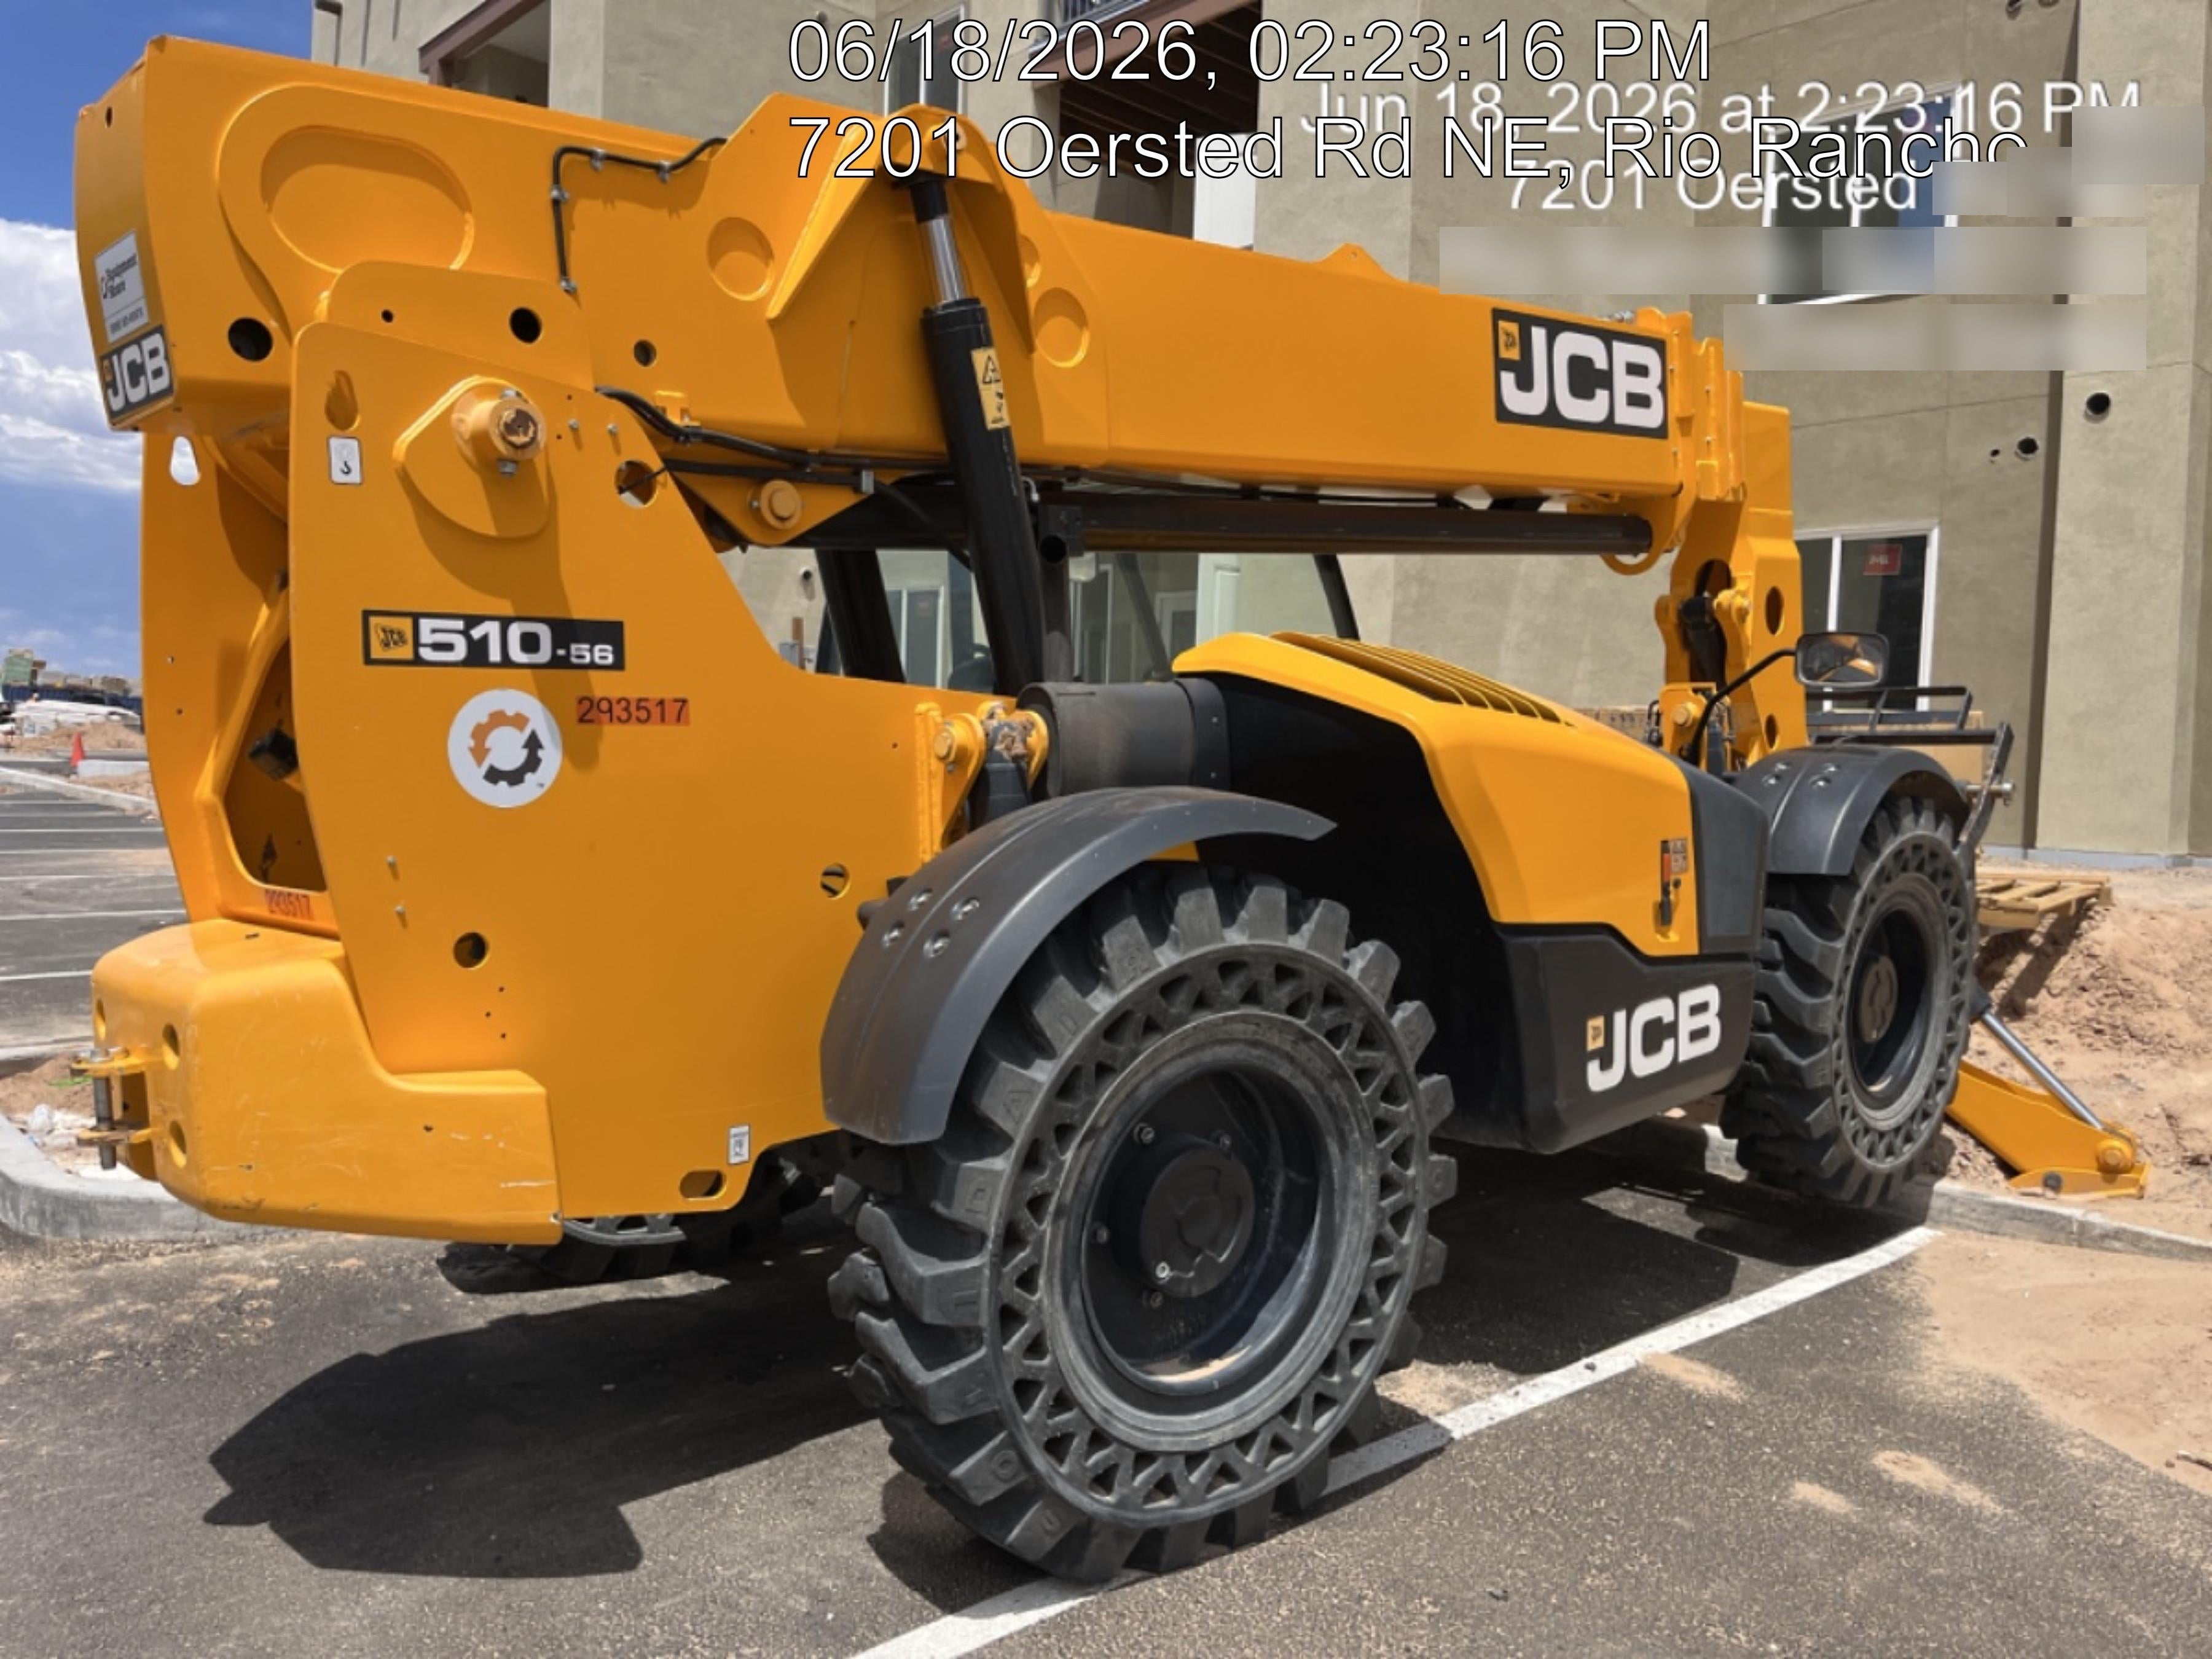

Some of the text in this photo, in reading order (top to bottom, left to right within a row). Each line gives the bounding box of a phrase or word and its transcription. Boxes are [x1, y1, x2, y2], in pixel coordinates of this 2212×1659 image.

[106, 332, 170, 412] JCB
[1499, 324, 1665, 429] JCB
[418, 618, 614, 665] 510-56
[577, 696, 689, 724] 293517
[1586, 983, 1720, 1092] JCB
